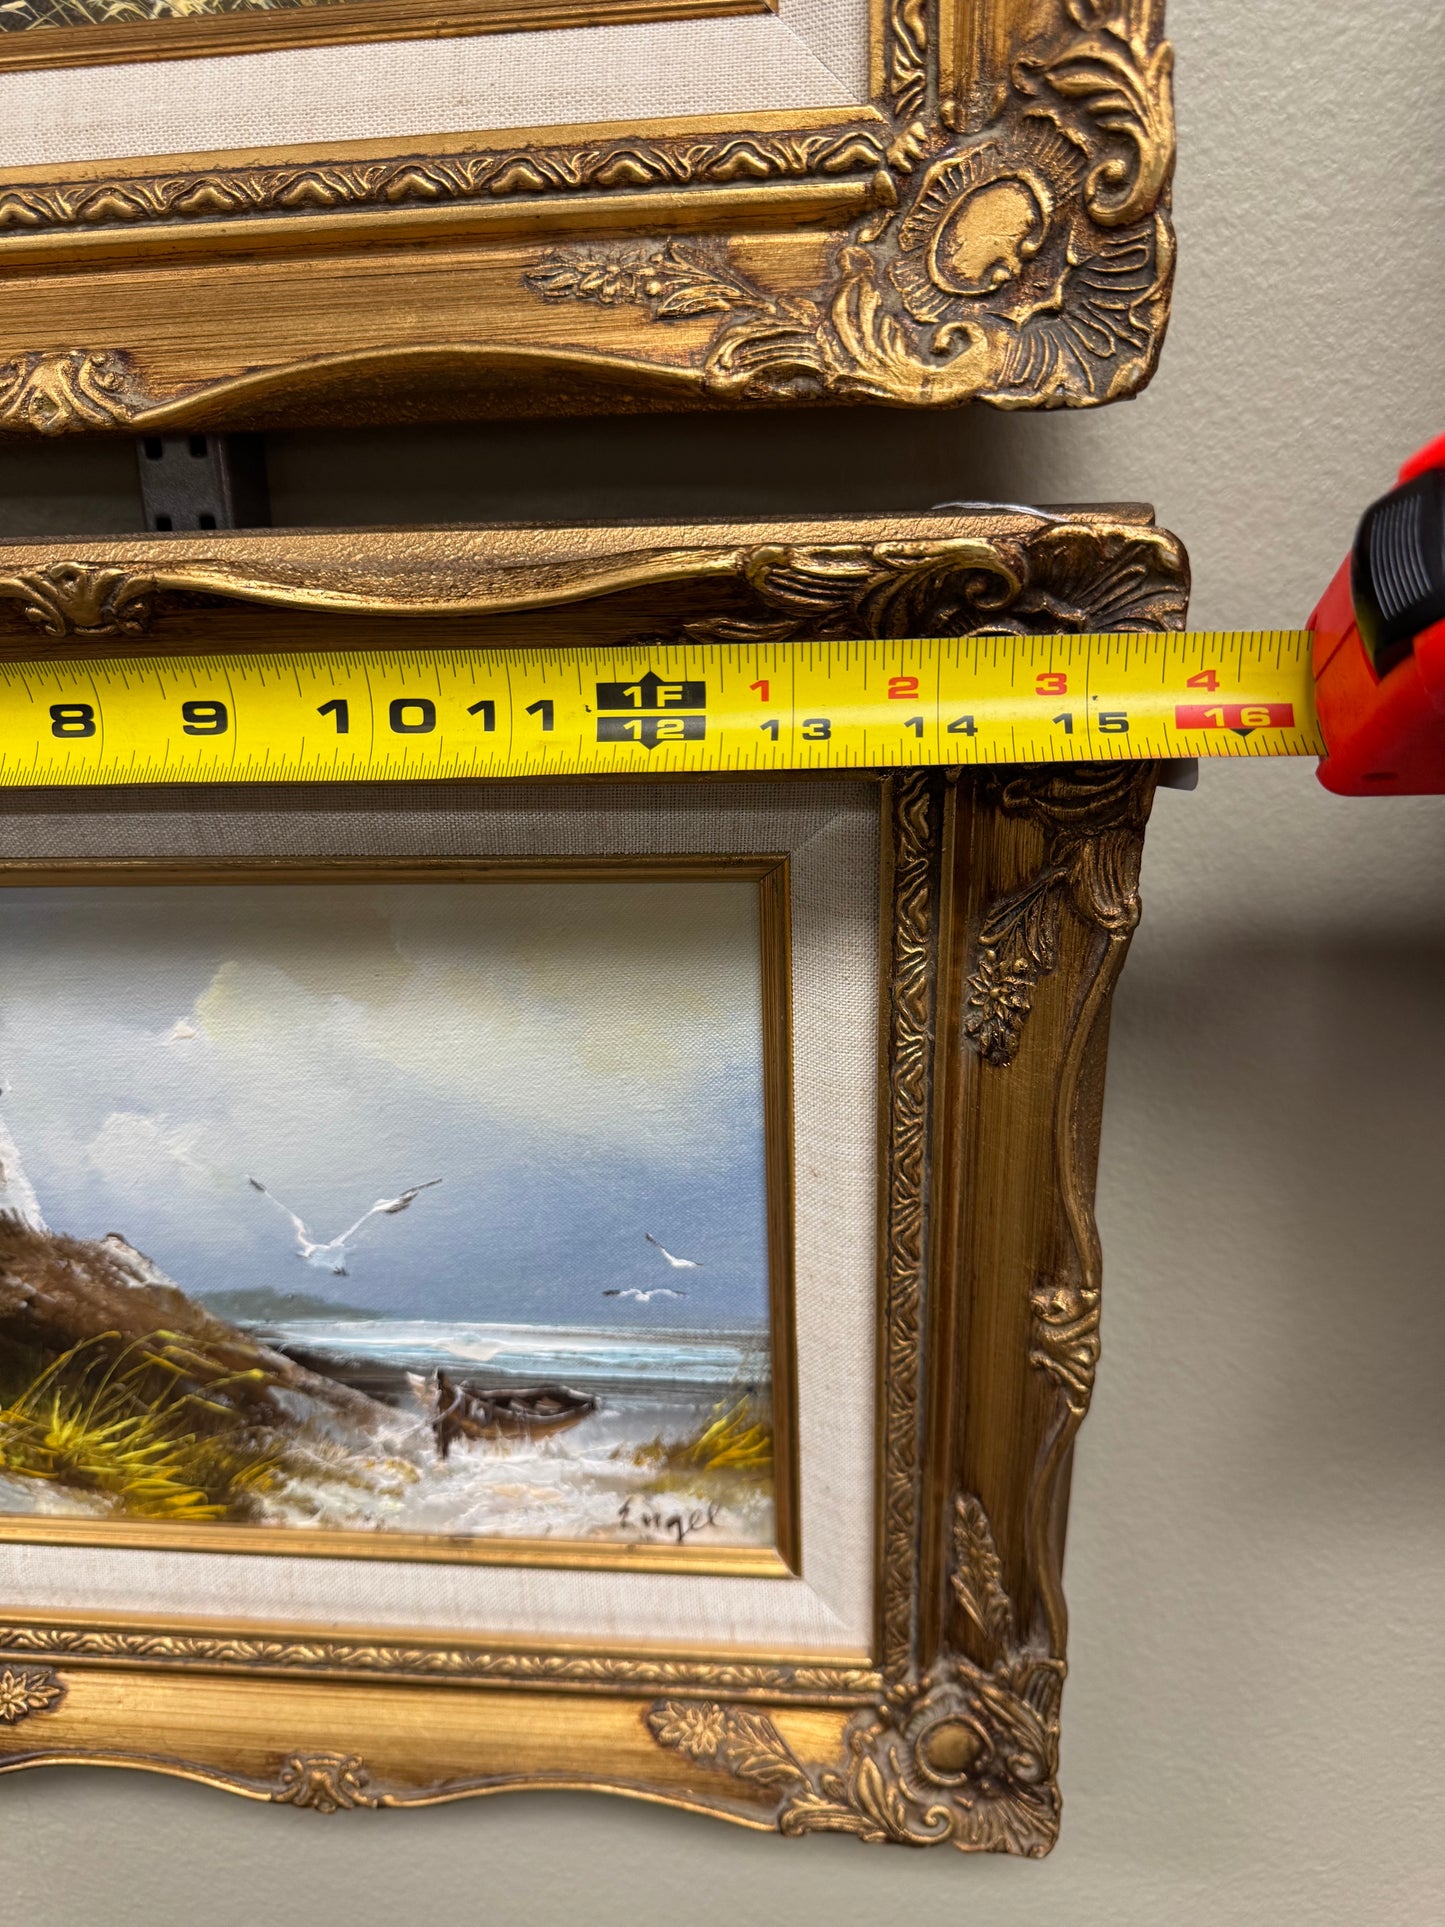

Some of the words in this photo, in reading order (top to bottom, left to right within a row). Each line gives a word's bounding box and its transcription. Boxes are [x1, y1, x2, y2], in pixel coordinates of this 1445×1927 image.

[622, 685, 683, 708] 1F
[749, 680, 770, 702] 1
[887, 677, 919, 700] 2
[1035, 673, 1068, 696] 3
[1186, 670, 1220, 692] 4
[50, 703, 96, 738] 8
[182, 701, 228, 735] 9
[317, 698, 436, 734] 10
[622, 719, 684, 740] 12
[760, 719, 831, 741] 13
[904, 715, 978, 739] 14
[1052, 711, 1129, 735] 15
[1203, 706, 1271, 727] 16
